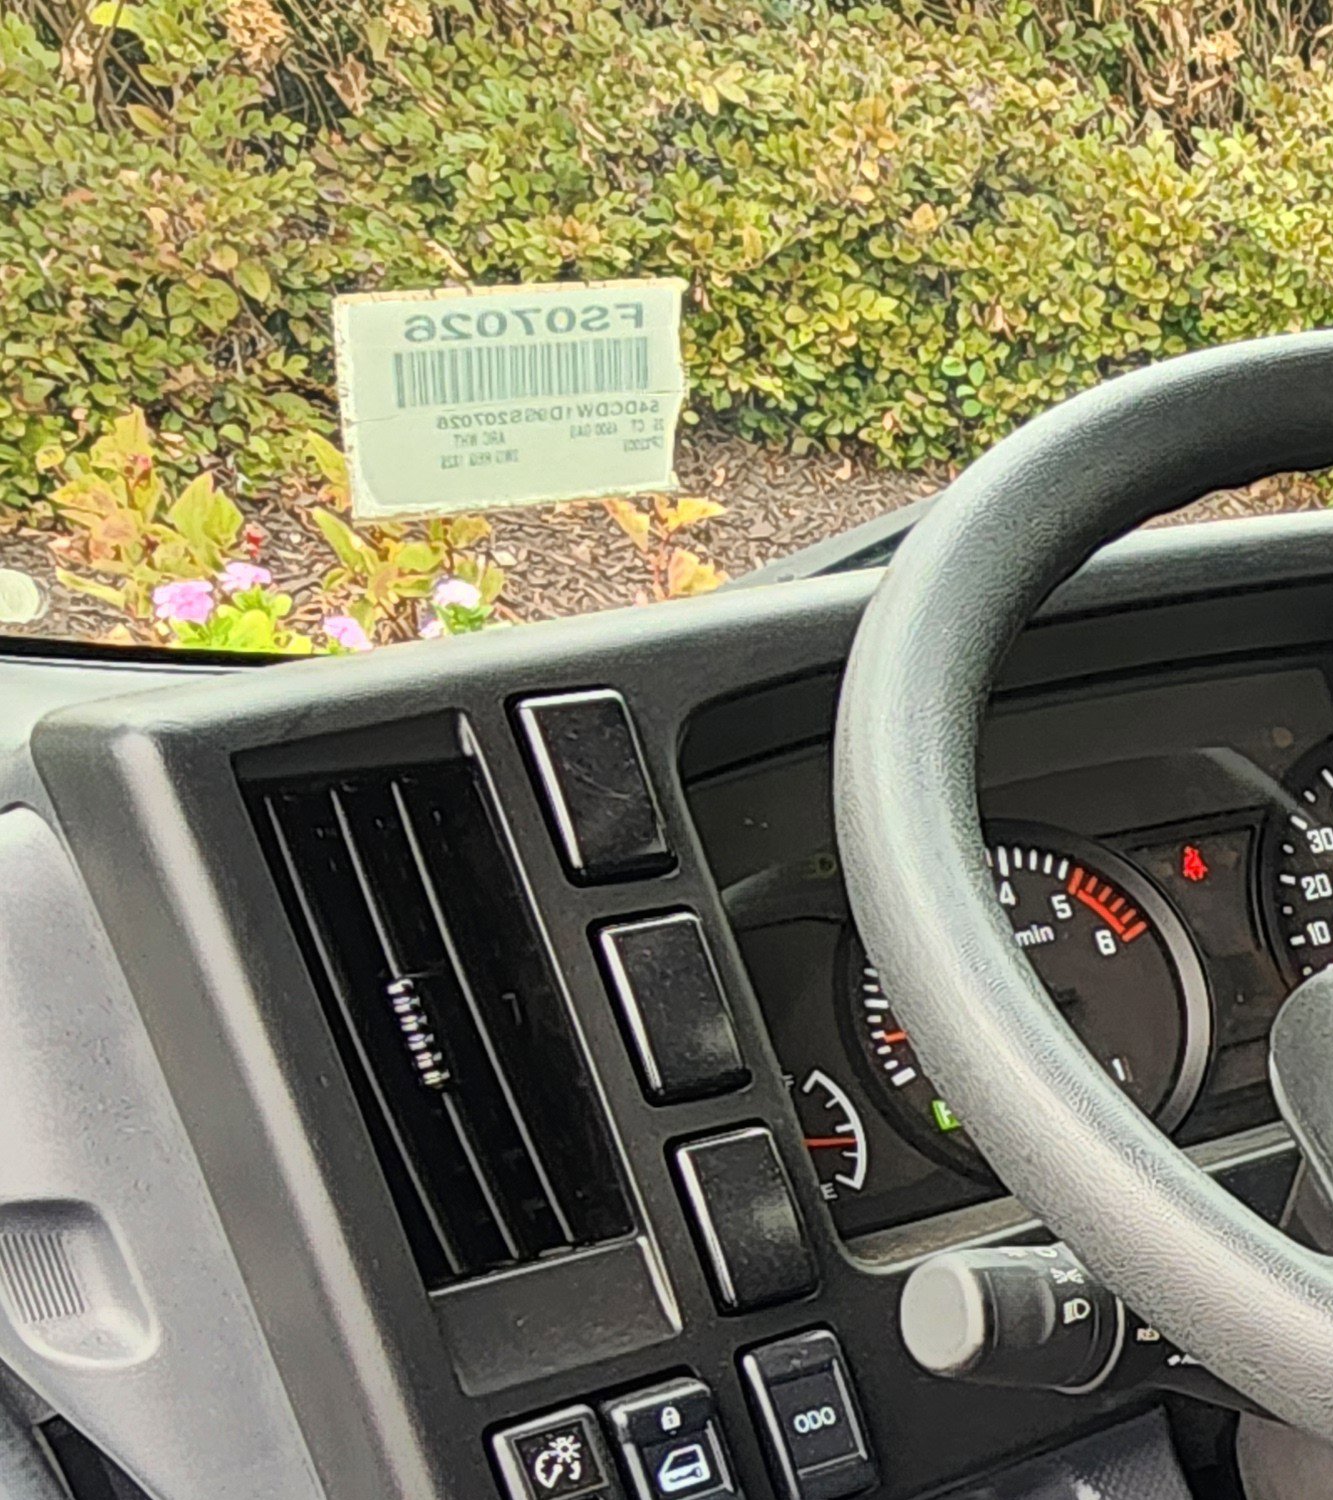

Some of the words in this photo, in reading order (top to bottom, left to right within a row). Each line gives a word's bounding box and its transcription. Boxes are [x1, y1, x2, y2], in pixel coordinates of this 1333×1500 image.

[1000, 881, 1016, 906] 4
[1301, 875, 1333, 901] 20
[1051, 894, 1072, 919] 5
[1095, 929, 1116, 956] 6
[1307, 921, 1331, 946] 10
[820, 1182, 838, 1200] E
[793, 1406, 836, 1434] ODO
